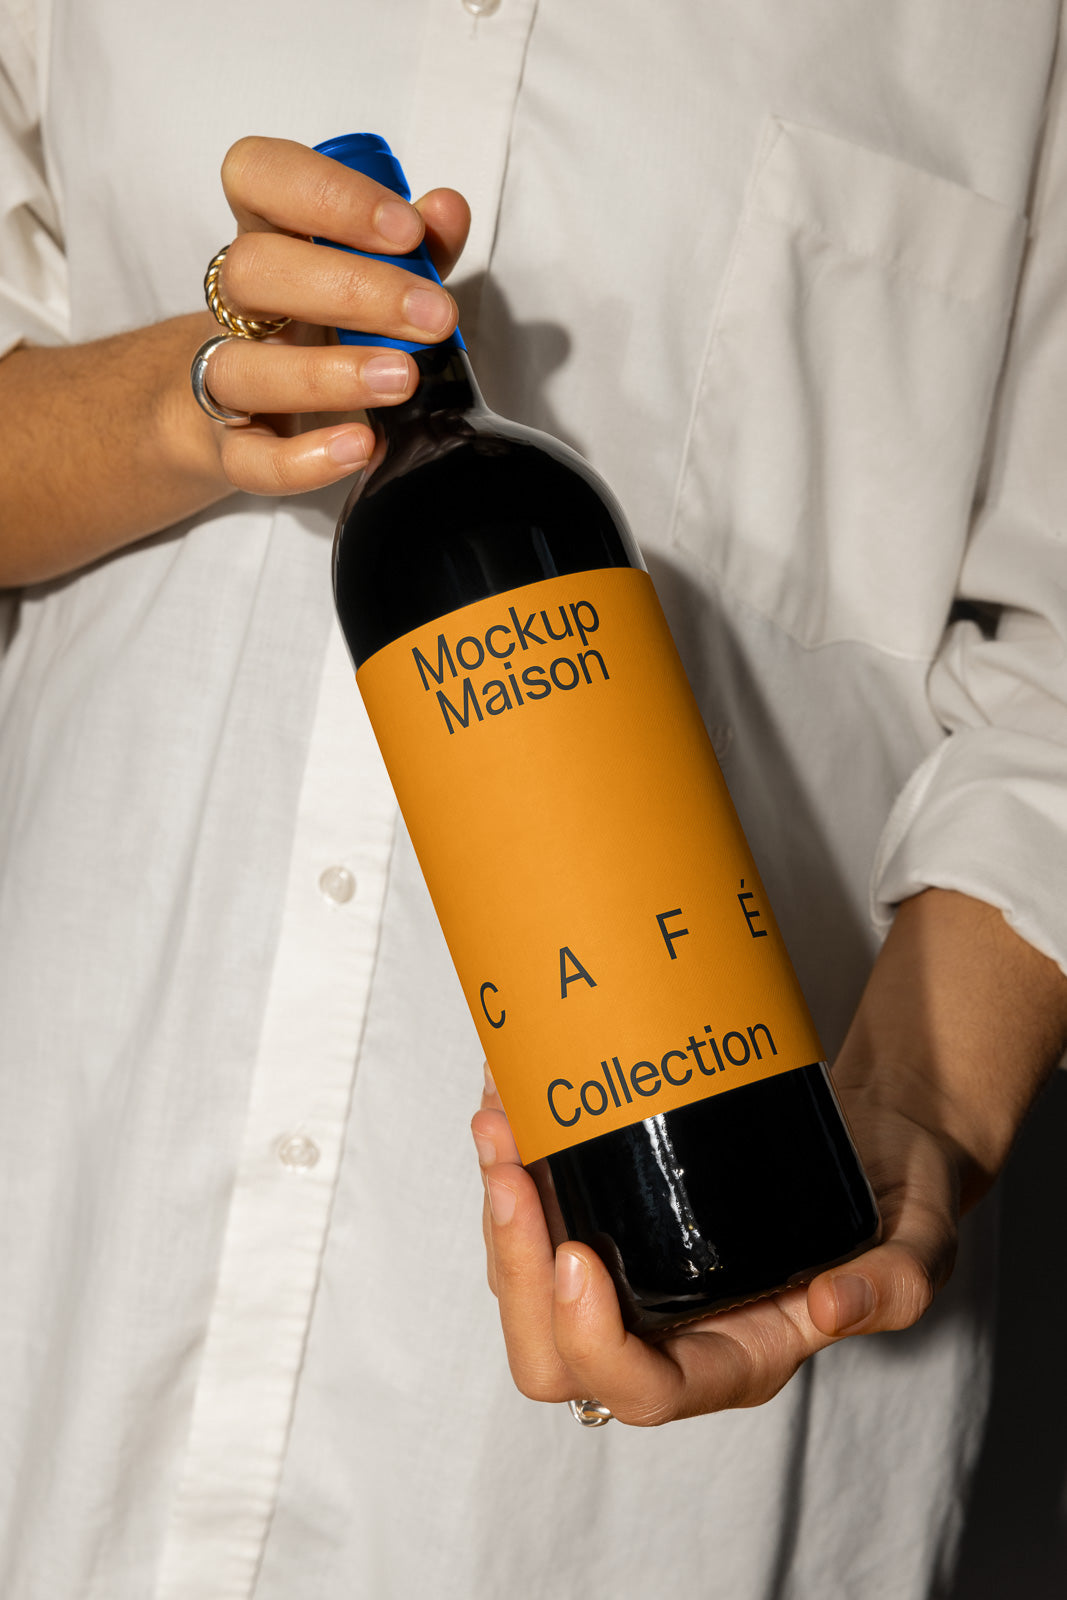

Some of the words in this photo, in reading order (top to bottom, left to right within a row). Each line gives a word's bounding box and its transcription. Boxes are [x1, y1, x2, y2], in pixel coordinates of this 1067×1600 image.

[412, 600, 600, 692] Mockup
[435, 649, 610, 735] Maison
[547, 1023, 778, 1128] Collection
